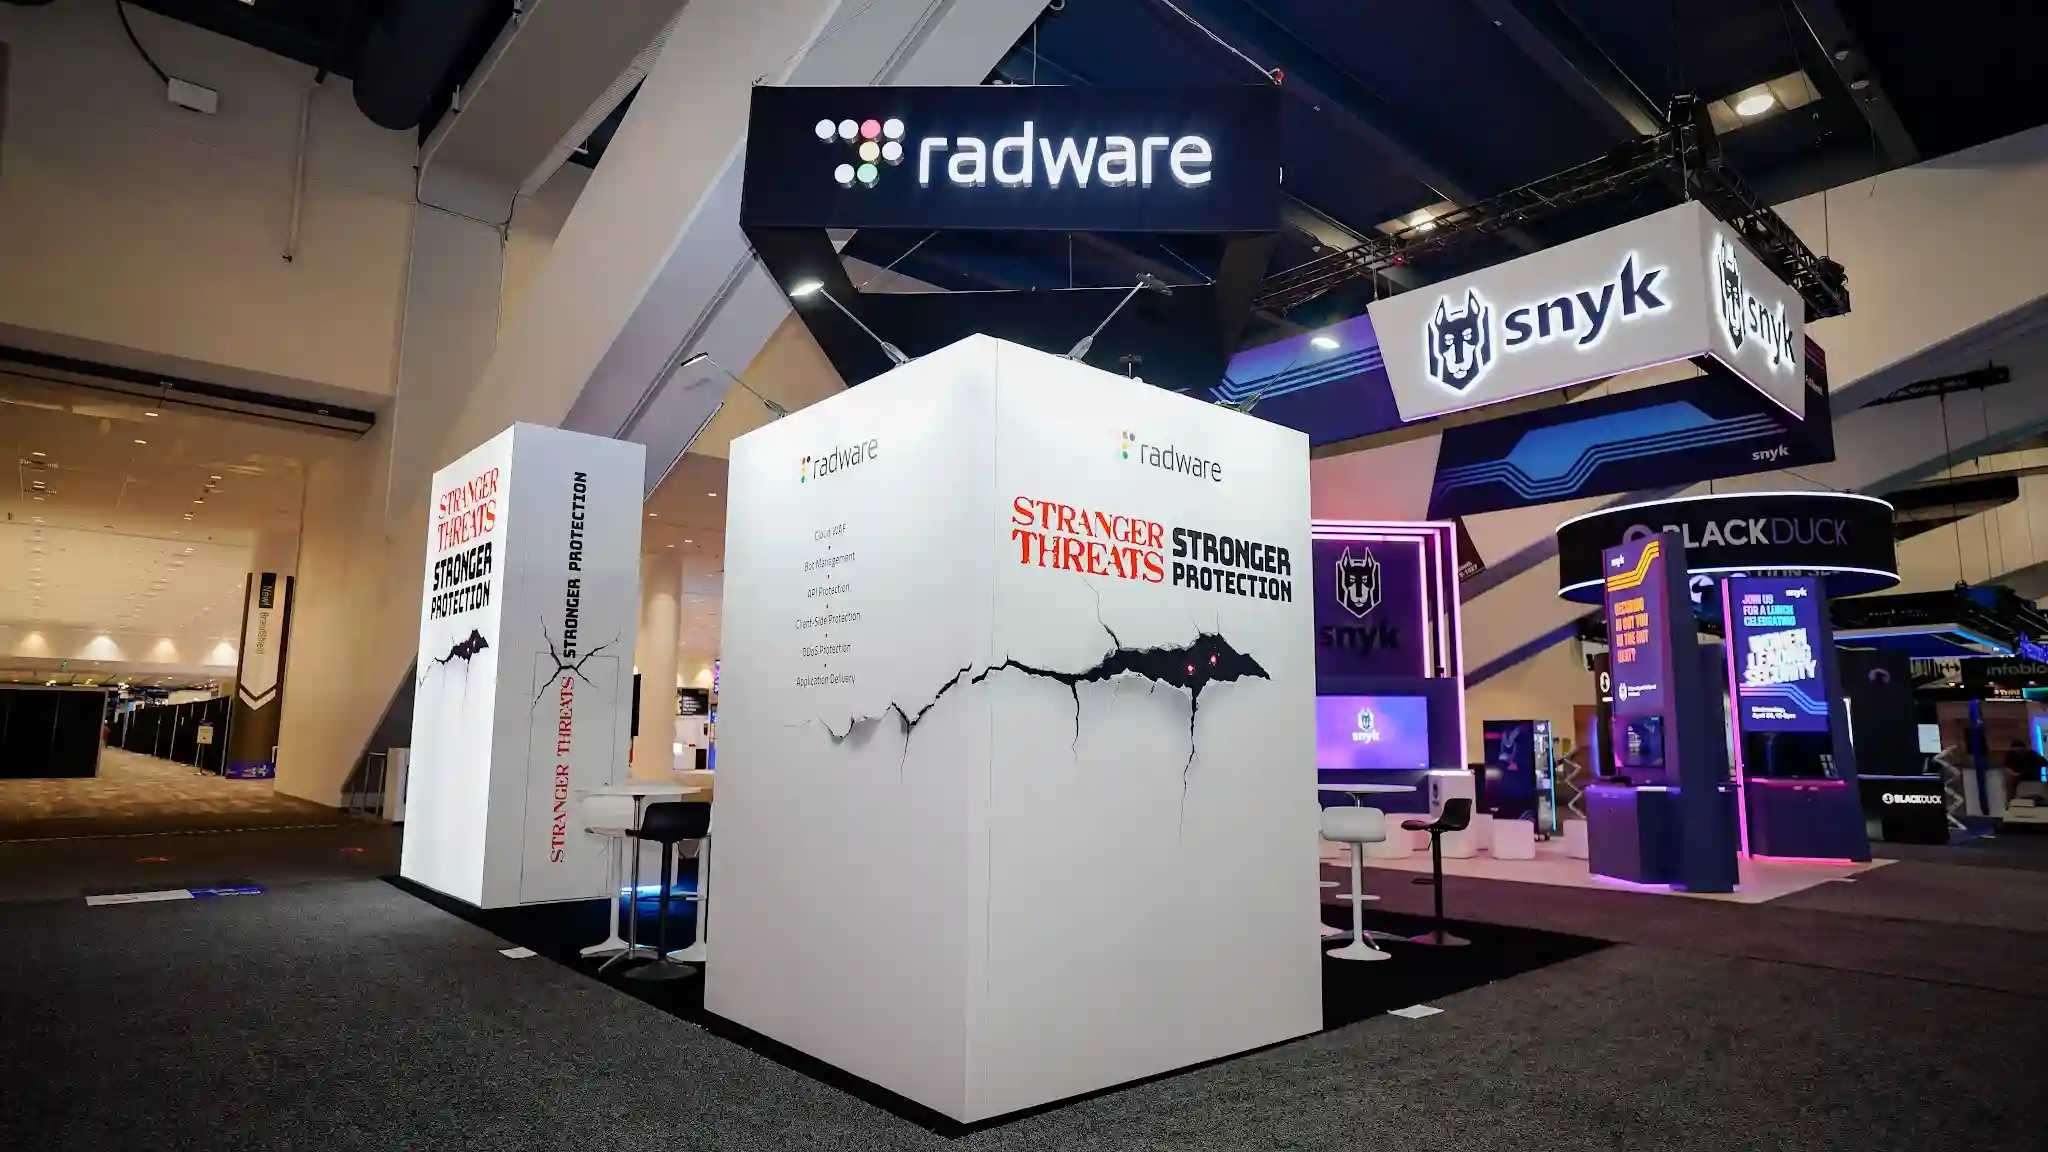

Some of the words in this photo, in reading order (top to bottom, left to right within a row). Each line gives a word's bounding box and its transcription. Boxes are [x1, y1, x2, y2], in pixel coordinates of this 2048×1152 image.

[918, 120, 1213, 188] radware
[1505, 253, 1668, 346] snyk
[1747, 297, 1797, 366] snyk
[812, 438, 879, 480] radware
[1140, 443, 1223, 482] radware
[1751, 443, 1790, 462] snyk
[438, 466, 500, 520] STRANGER
[436, 498, 497, 553] THREATS
[569, 471, 588, 573] PROTECTION
[1011, 496, 1165, 550] STRANGER
[1662, 518, 1847, 549] LACKDUCK
[432, 541, 493, 592] STRONGER
[815, 551, 856, 568] Management
[1011, 528, 1165, 584] THREATS
[1172, 526, 1292, 577] STRONGER
[430, 579, 491, 620] PROTECTION
[807, 588, 818, 598] API
[819, 583, 850, 597] Protection
[1172, 561, 1293, 603] PROTECTION
[1761, 593, 1774, 605] US
[563, 575, 582, 659] STRONGER
[795, 616, 828, 630] Client-Side
[828, 612, 861, 624] Protection
[1742, 604, 1759, 616] FOR
[1759, 604, 1767, 616] A
[1743, 615, 1797, 627] CELEBRATING
[802, 645, 819, 657] DDoS
[819, 644, 851, 655] Protection
[1318, 617, 1400, 656] snyk
[796, 675, 829, 689] Application
[829, 673, 856, 685] Delivery
[557, 675, 575, 757] THREATS
[1351, 729, 1381, 744] snyk
[550, 763, 571, 863] STRANGER
